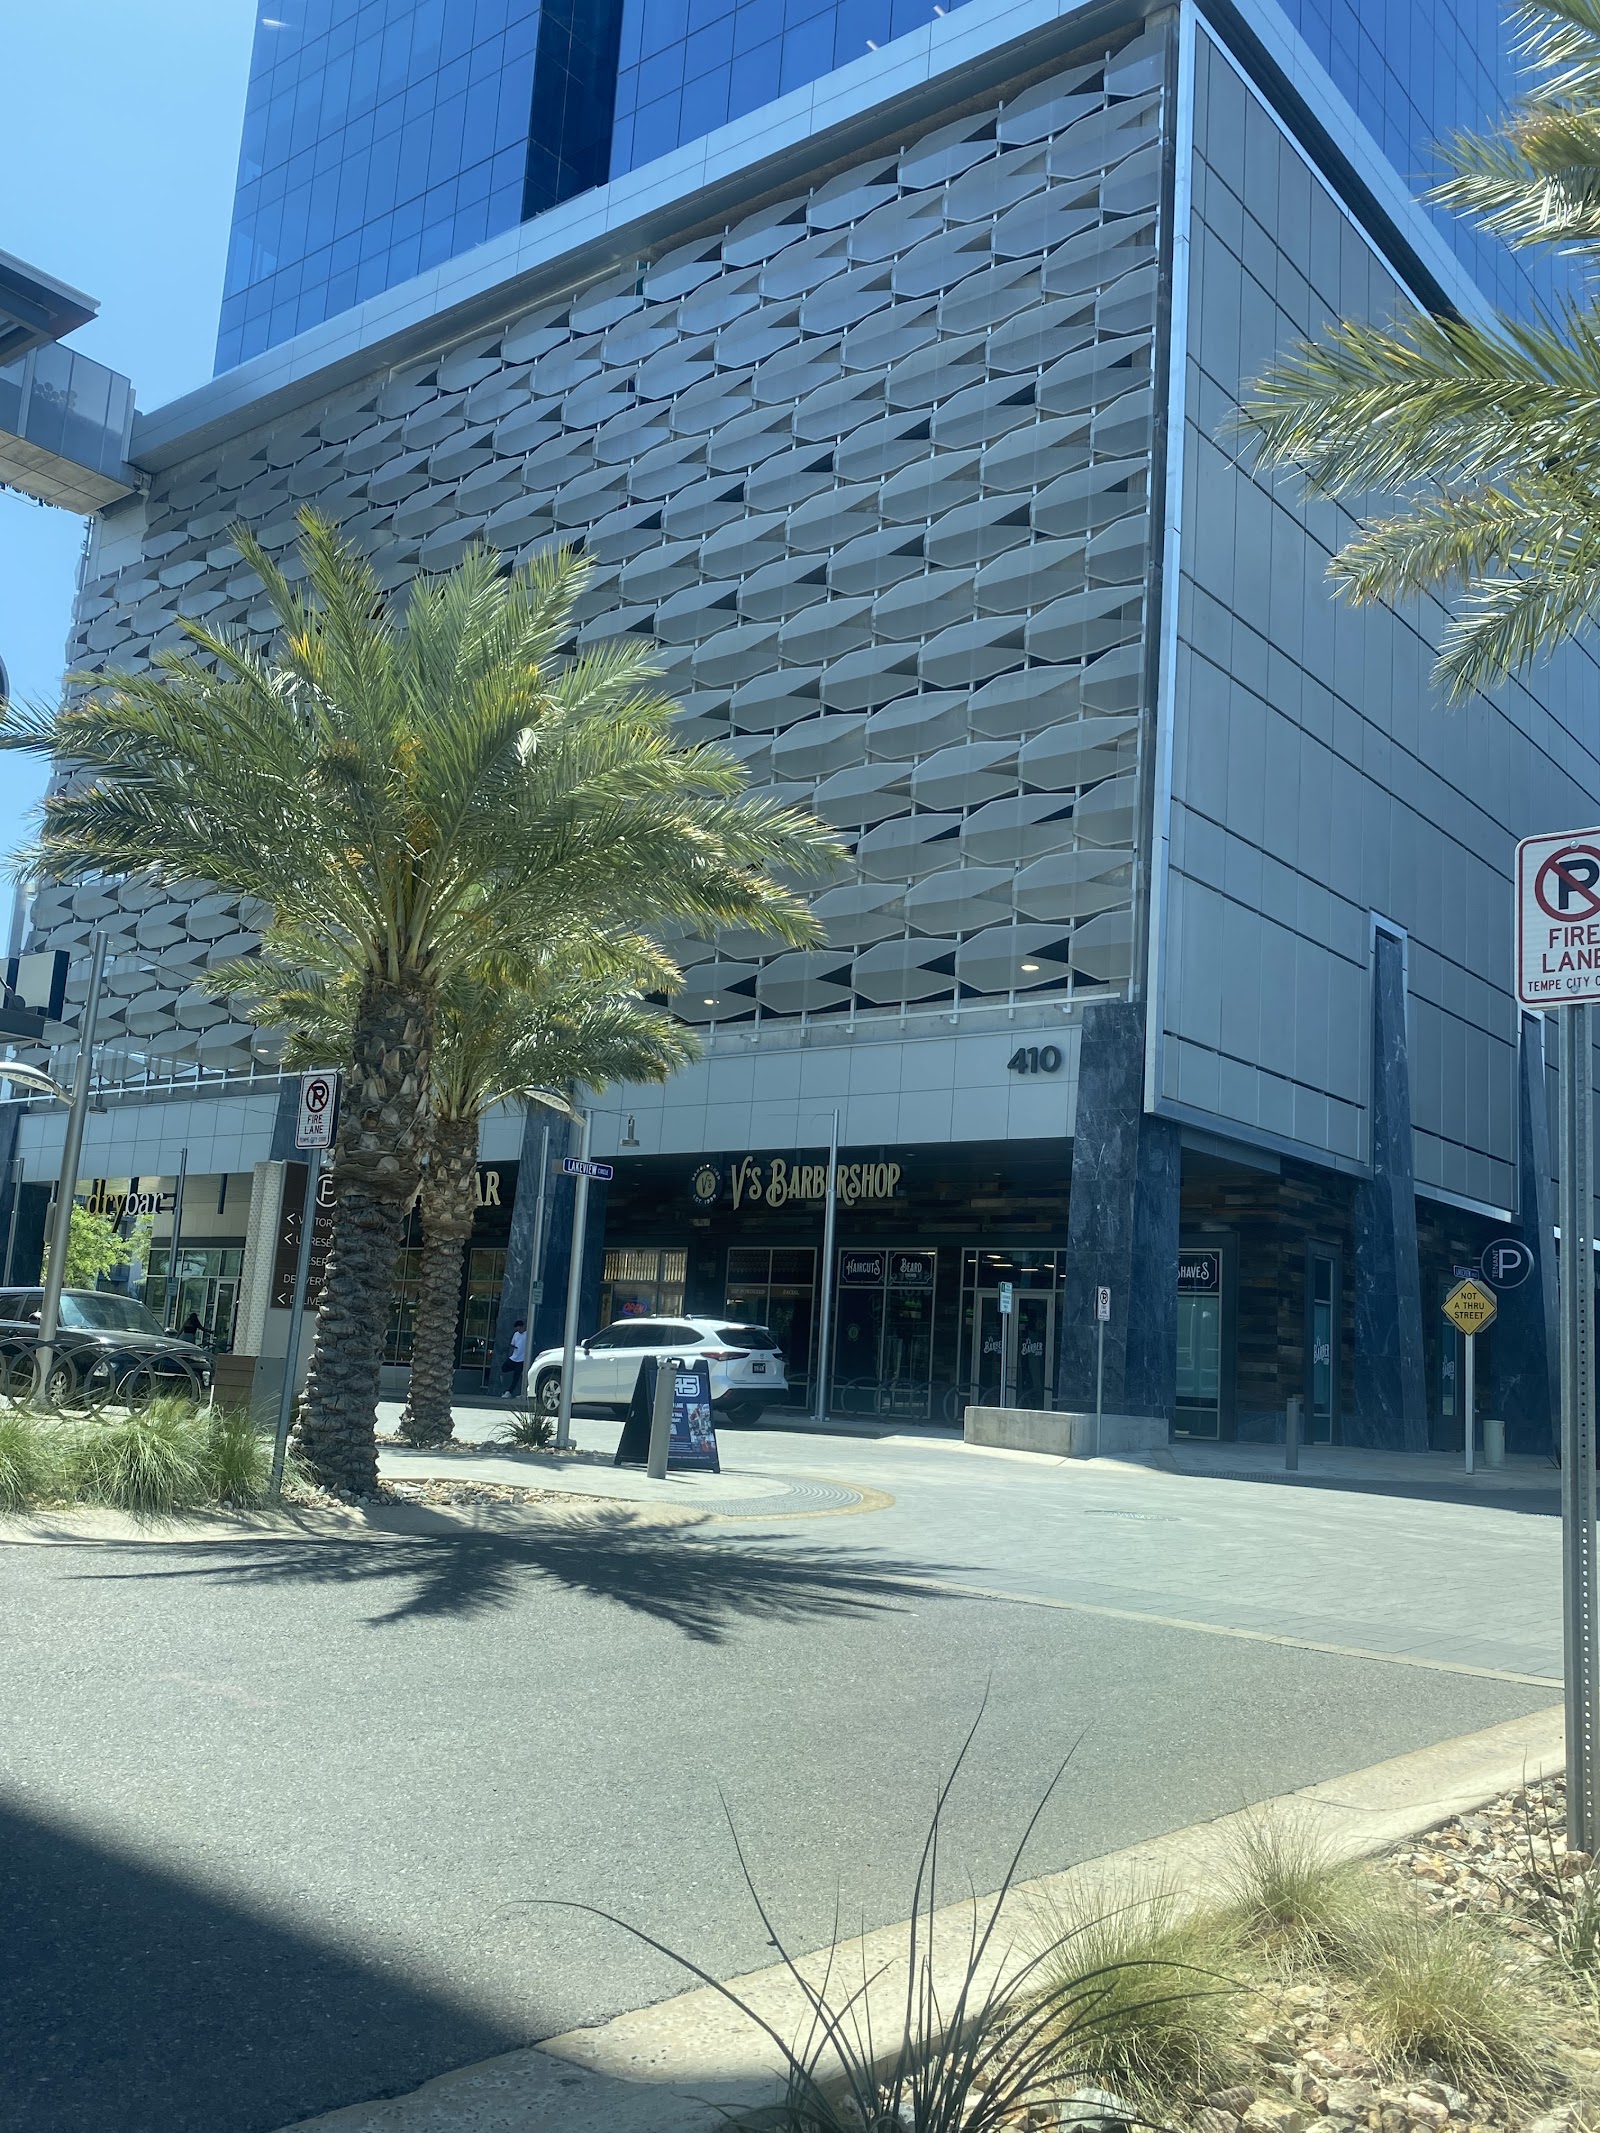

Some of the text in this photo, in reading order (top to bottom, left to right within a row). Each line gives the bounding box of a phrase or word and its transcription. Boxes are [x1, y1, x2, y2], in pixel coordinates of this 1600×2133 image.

[1549, 924, 1600, 949] FIRE
[1528, 979, 1561, 992] TEMPE
[1566, 976, 1590, 989] CITY
[1007, 1045, 1062, 1074] 410
[307, 1115, 323, 1124] FIRE
[304, 1125, 323, 1134] LANE
[567, 1160, 598, 1176] LAKEVIEW
[474, 1171, 501, 1206] AR
[766, 1158, 900, 1207] BARBRSHOP
[86, 1179, 164, 1233] drybar
[846, 1259, 881, 1276] HAIRCUTS
[900, 1258, 923, 1273] BEARD
[1178, 1262, 1210, 1280] HAVES
[1460, 1292, 1478, 1300] NOT
[623, 1302, 645, 1313] OPEN
[1463, 1302, 1485, 1310] THRU
[1454, 1312, 1484, 1320] STREET
[674, 1377, 697, 1394] 45
